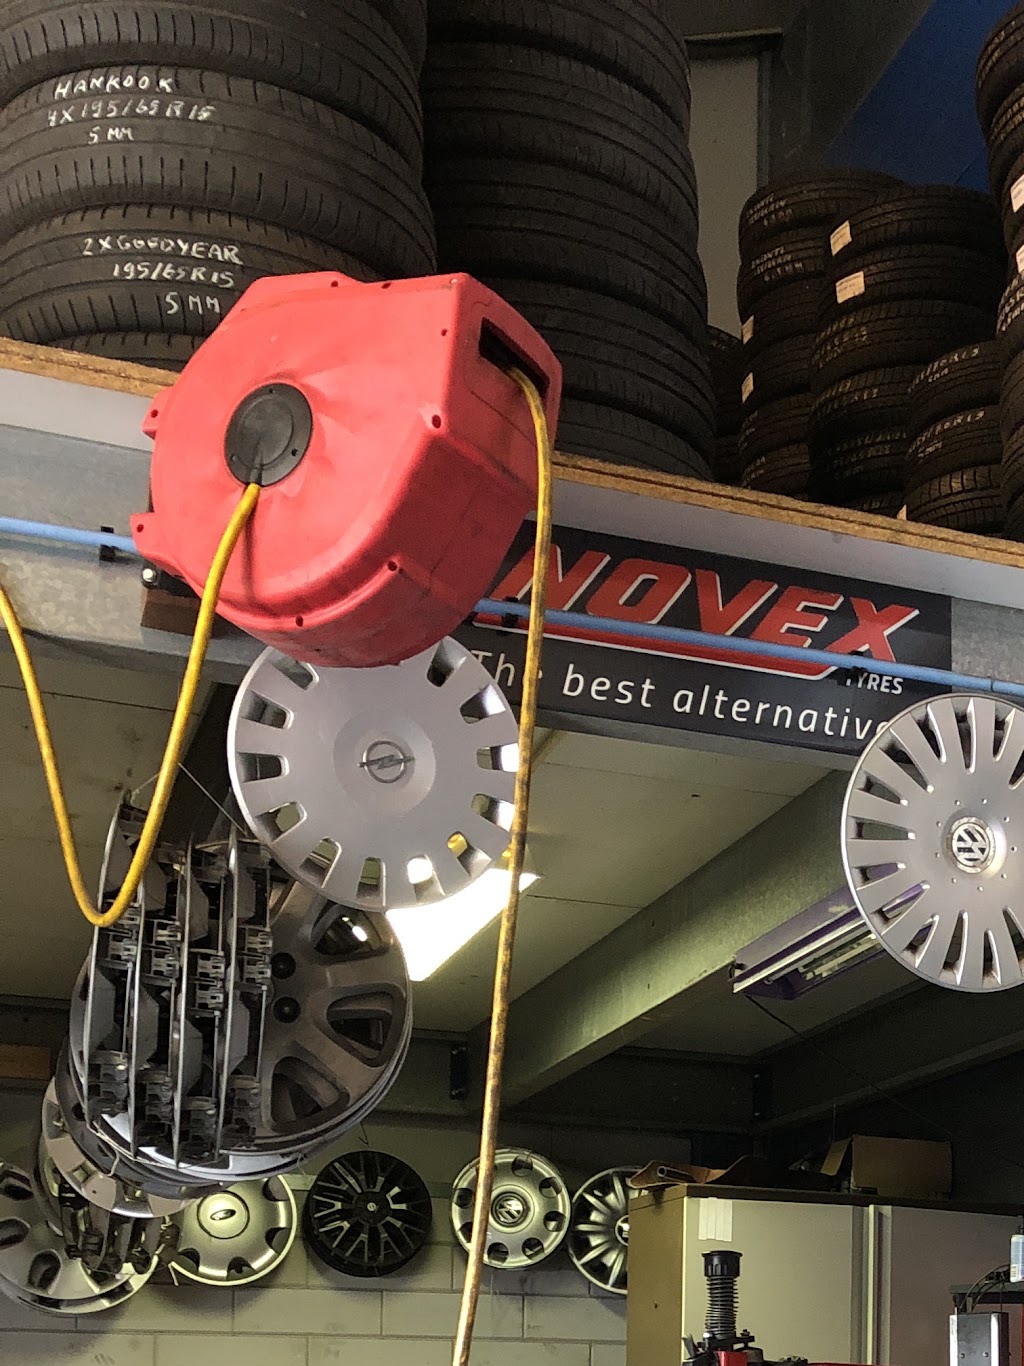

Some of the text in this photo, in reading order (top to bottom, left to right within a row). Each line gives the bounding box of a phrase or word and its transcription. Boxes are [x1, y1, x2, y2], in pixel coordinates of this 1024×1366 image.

[490, 544, 919, 663] NOVEX
[470, 649, 543, 687] Th
[562, 663, 653, 709] best
